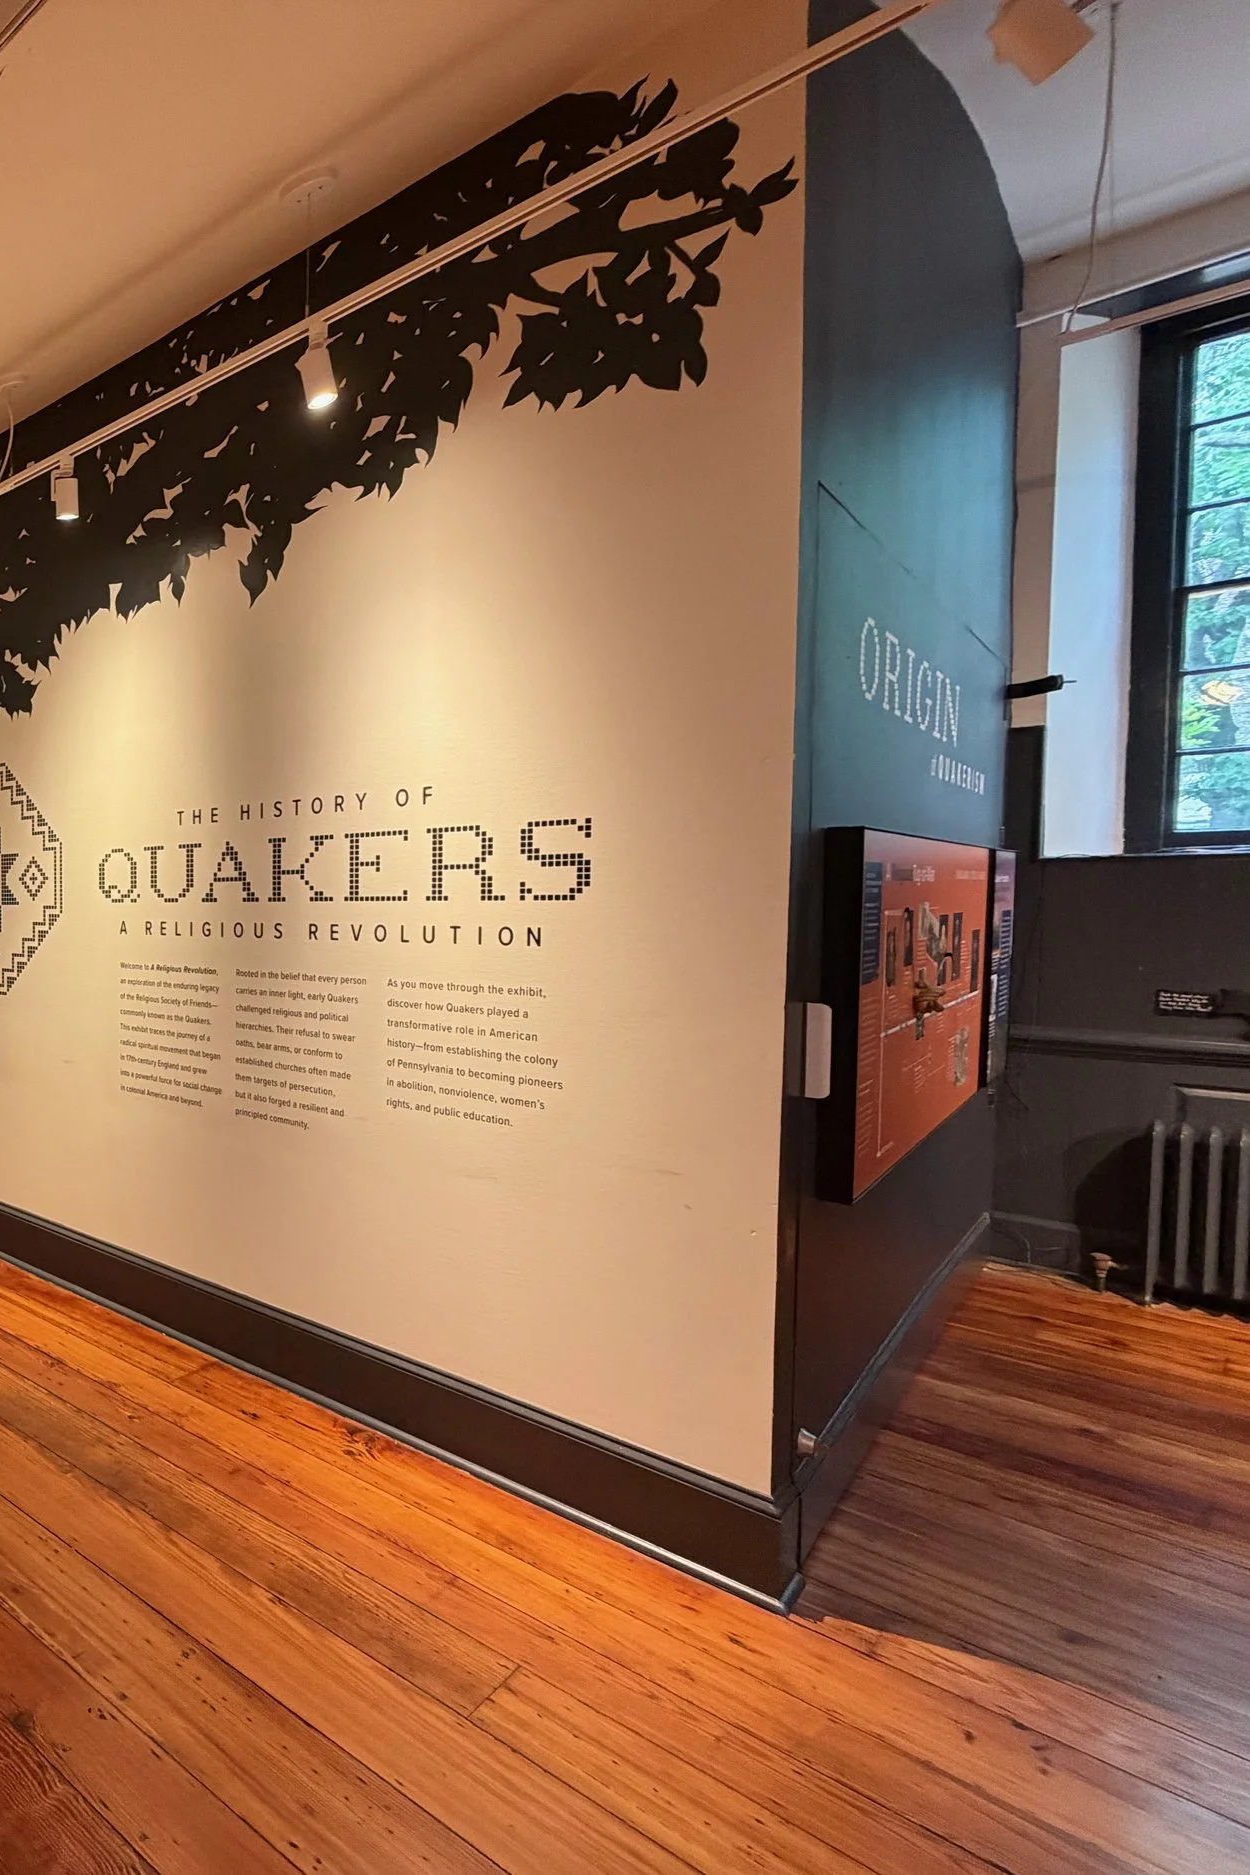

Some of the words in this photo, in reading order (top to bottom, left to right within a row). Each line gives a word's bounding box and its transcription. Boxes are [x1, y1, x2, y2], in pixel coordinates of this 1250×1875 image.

[860, 617, 961, 747] ORIGIN
[177, 807, 218, 825] THE
[240, 793, 367, 820] HISTORY
[395, 786, 433, 807] OF
[99, 817, 592, 903] QUAKERS
[119, 920, 128, 935] A
[145, 921, 283, 939] RELIGIOUS
[308, 923, 542, 947] REVOLUTION
[156, 965, 182, 973] Religious
[184, 966, 218, 975] Revolution,
[236, 969, 258, 978] Rooted
[260, 970, 266, 978] in
[268, 971, 279, 979] the
[281, 971, 300, 980] belief
[318, 975, 338, 985] every
[340, 976, 366, 985] person
[173, 982, 198, 992] enduring
[200, 984, 219, 994] legacy
[236, 987, 257, 995] carries
[269, 989, 286, 997] inner
[287, 990, 305, 1000] light,
[307, 993, 326, 1003] early
[327, 993, 358, 1004] Quakers
[387, 978, 398, 987] As
[400, 980, 416, 990] you
[419, 982, 444, 991] move
[447, 983, 484, 995] through
[488, 985, 504, 994] the
[507, 986, 547, 998] exhibit,
[136, 994, 159, 1003] Religious
[161, 997, 180, 1006] Society
[387, 999, 422, 1010] discover
[425, 1001, 444, 1011] how
[446, 1003, 484, 1015] Quakers
[487, 1006, 520, 1019] played
[522, 1010, 528, 1019] a
[120, 1009, 146, 1018] commonly
[147, 1011, 165, 1019] known
[185, 1015, 212, 1025] Quakers.
[236, 1004, 271, 1015] challenged
[273, 1007, 302, 1018] religious
[304, 1011, 317, 1019] and
[319, 1011, 349, 1022] political
[149, 1027, 165, 1035] traces
[176, 1030, 197, 1041] journey
[235, 1021, 274, 1033] hierarchies.
[276, 1025, 294, 1035] Their
[296, 1028, 320, 1038] refusal
[322, 1031, 330, 1039] to
[332, 1033, 355, 1042] swear
[387, 1019, 452, 1033] transformative
[455, 1025, 474, 1036] role
[477, 1026, 486, 1036] in
[490, 1028, 538, 1042] American
[120, 1039, 136, 1047] radical
[160, 1046, 188, 1054] movement
[189, 1049, 201, 1057] that
[202, 1051, 221, 1060] began
[235, 1040, 255, 1049] oaths,
[257, 1041, 272, 1049] bear
[273, 1044, 292, 1054] arms,
[303, 1048, 333, 1058] conform
[335, 1052, 342, 1060] to
[387, 1038, 444, 1053] history—from
[446, 1045, 502, 1062] establishing
[505, 1052, 521, 1062] the
[524, 1054, 558, 1068] colony
[126, 1055, 156, 1067] 17th-century
[158, 1060, 179, 1069] England
[235, 1057, 273, 1068] established
[275, 1062, 306, 1073] churches
[308, 1067, 327, 1076] often
[330, 1070, 351, 1080] made
[120, 1068, 130, 1076] into
[135, 1072, 157, 1082] powerful
[159, 1075, 172, 1085] force
[183, 1081, 199, 1089] social
[200, 1083, 222, 1095] change
[387, 1058, 395, 1067] of
[398, 1059, 454, 1075] Pennsylvania
[456, 1067, 466, 1076] to
[468, 1068, 515, 1085] becoming
[518, 1075, 563, 1090] pioneers
[235, 1073, 252, 1082] them
[254, 1076, 278, 1087] targets
[289, 1082, 336, 1098] persecution,
[387, 1077, 394, 1086] in
[397, 1081, 436, 1094] abolition,
[439, 1086, 498, 1104] nonviolence,
[500, 1096, 545, 1110] women's
[147, 1089, 168, 1099] America
[181, 1096, 203, 1107] beyond.
[235, 1090, 245, 1099] but
[247, 1092, 251, 1100] it
[253, 1094, 267, 1102] also
[268, 1096, 290, 1107] forged
[299, 1102, 328, 1114] resilient
[330, 1108, 345, 1117] and
[235, 1108, 268, 1120] principled
[270, 1114, 309, 1130] community.
[386, 1097, 413, 1111] rights,
[415, 1103, 431, 1113] and
[433, 1105, 461, 1118] public
[463, 1111, 513, 1127] education.
